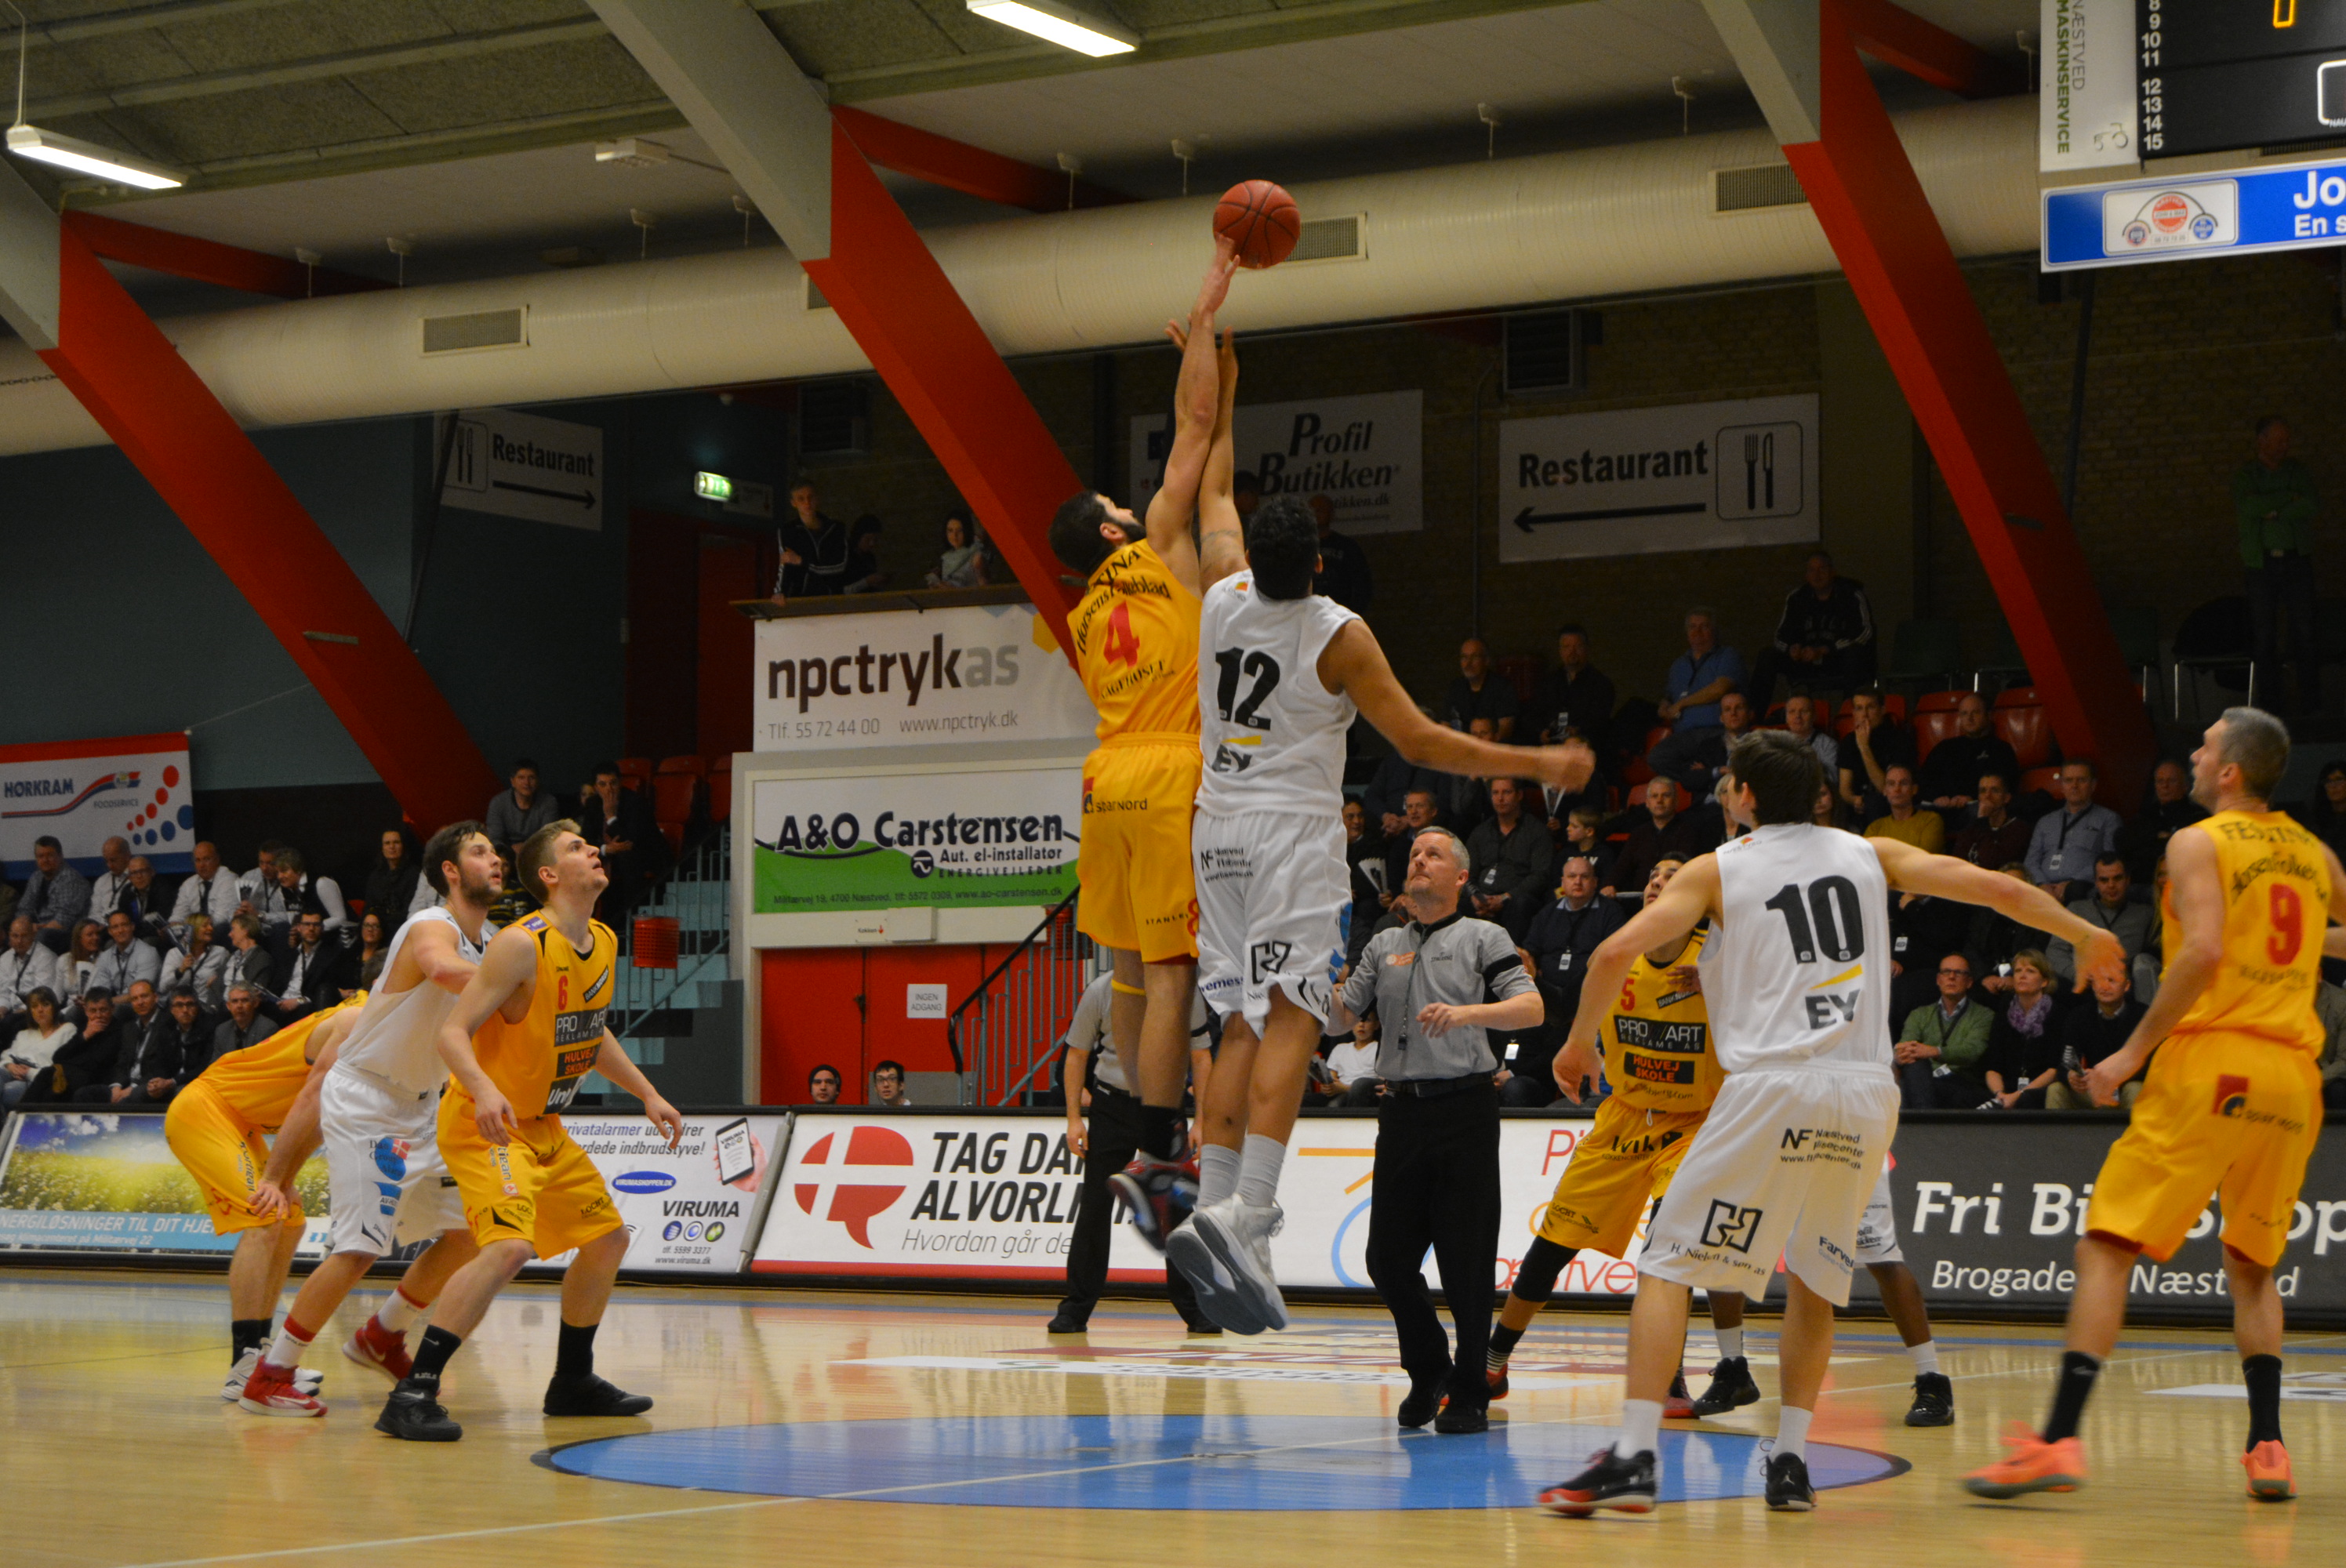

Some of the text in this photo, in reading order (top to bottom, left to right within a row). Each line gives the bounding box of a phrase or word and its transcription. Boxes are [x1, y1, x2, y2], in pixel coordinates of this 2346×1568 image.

[2149, 13, 2161, 30] 9
[2141, 31, 2162, 49] 10
[2141, 49, 2160, 67] 11
[2141, 78, 2162, 96] 12
[2142, 96, 2163, 114] 13
[2143, 114, 2163, 132] 14
[2143, 133, 2164, 151] 15
[2293, 171, 2346, 209] Jo
[2294, 215, 2327, 238] En
[1288, 412, 1373, 457] Profil
[492, 434, 594, 477] Restaurant
[1519, 439, 1709, 488] Restaurant
[1259, 452, 1393, 495] Butikken
[1103, 600, 1141, 669] 4
[1215, 647, 1280, 731] 12
[795, 722, 812, 739] 55
[816, 720, 833, 738] 72
[836, 719, 856, 736] 44
[860, 717, 880, 735] 00
[899, 710, 1019, 731] www.npctryk.dk
[1211, 743, 1253, 772] EY
[775, 811, 1062, 852] A&O Carstensen
[939, 846, 1062, 863] Aut. el-installatør
[1765, 875, 1865, 965] 10
[2268, 882, 2302, 966] 9
[557, 975, 568, 1011] 6
[915, 993, 939, 1001] INGEN
[1620, 978, 1636, 1011] 5
[910, 1003, 942, 1011] ADGANG
[1805, 989, 1861, 1030] EY
[556, 1014, 578, 1034] PRO
[1618, 1018, 1702, 1042] PRO ART
[564, 1047, 594, 1064] HULVEJ
[565, 1061, 590, 1075] SKOLE
[1633, 1055, 1680, 1072] HULVEJ
[1636, 1067, 1676, 1083] SKOLE
[932, 1131, 1010, 1175] TAG
[663, 1200, 740, 1218] VIRUMA
[1912, 1181, 2003, 1235] Fri
[128, 1216, 149, 1232] TIL
[153, 1217, 182, 1232] DIT
[902, 1229, 996, 1254] Hvordan
[1001, 1226, 1042, 1259] går
[1931, 1259, 2301, 1298] Brogade Næstd
